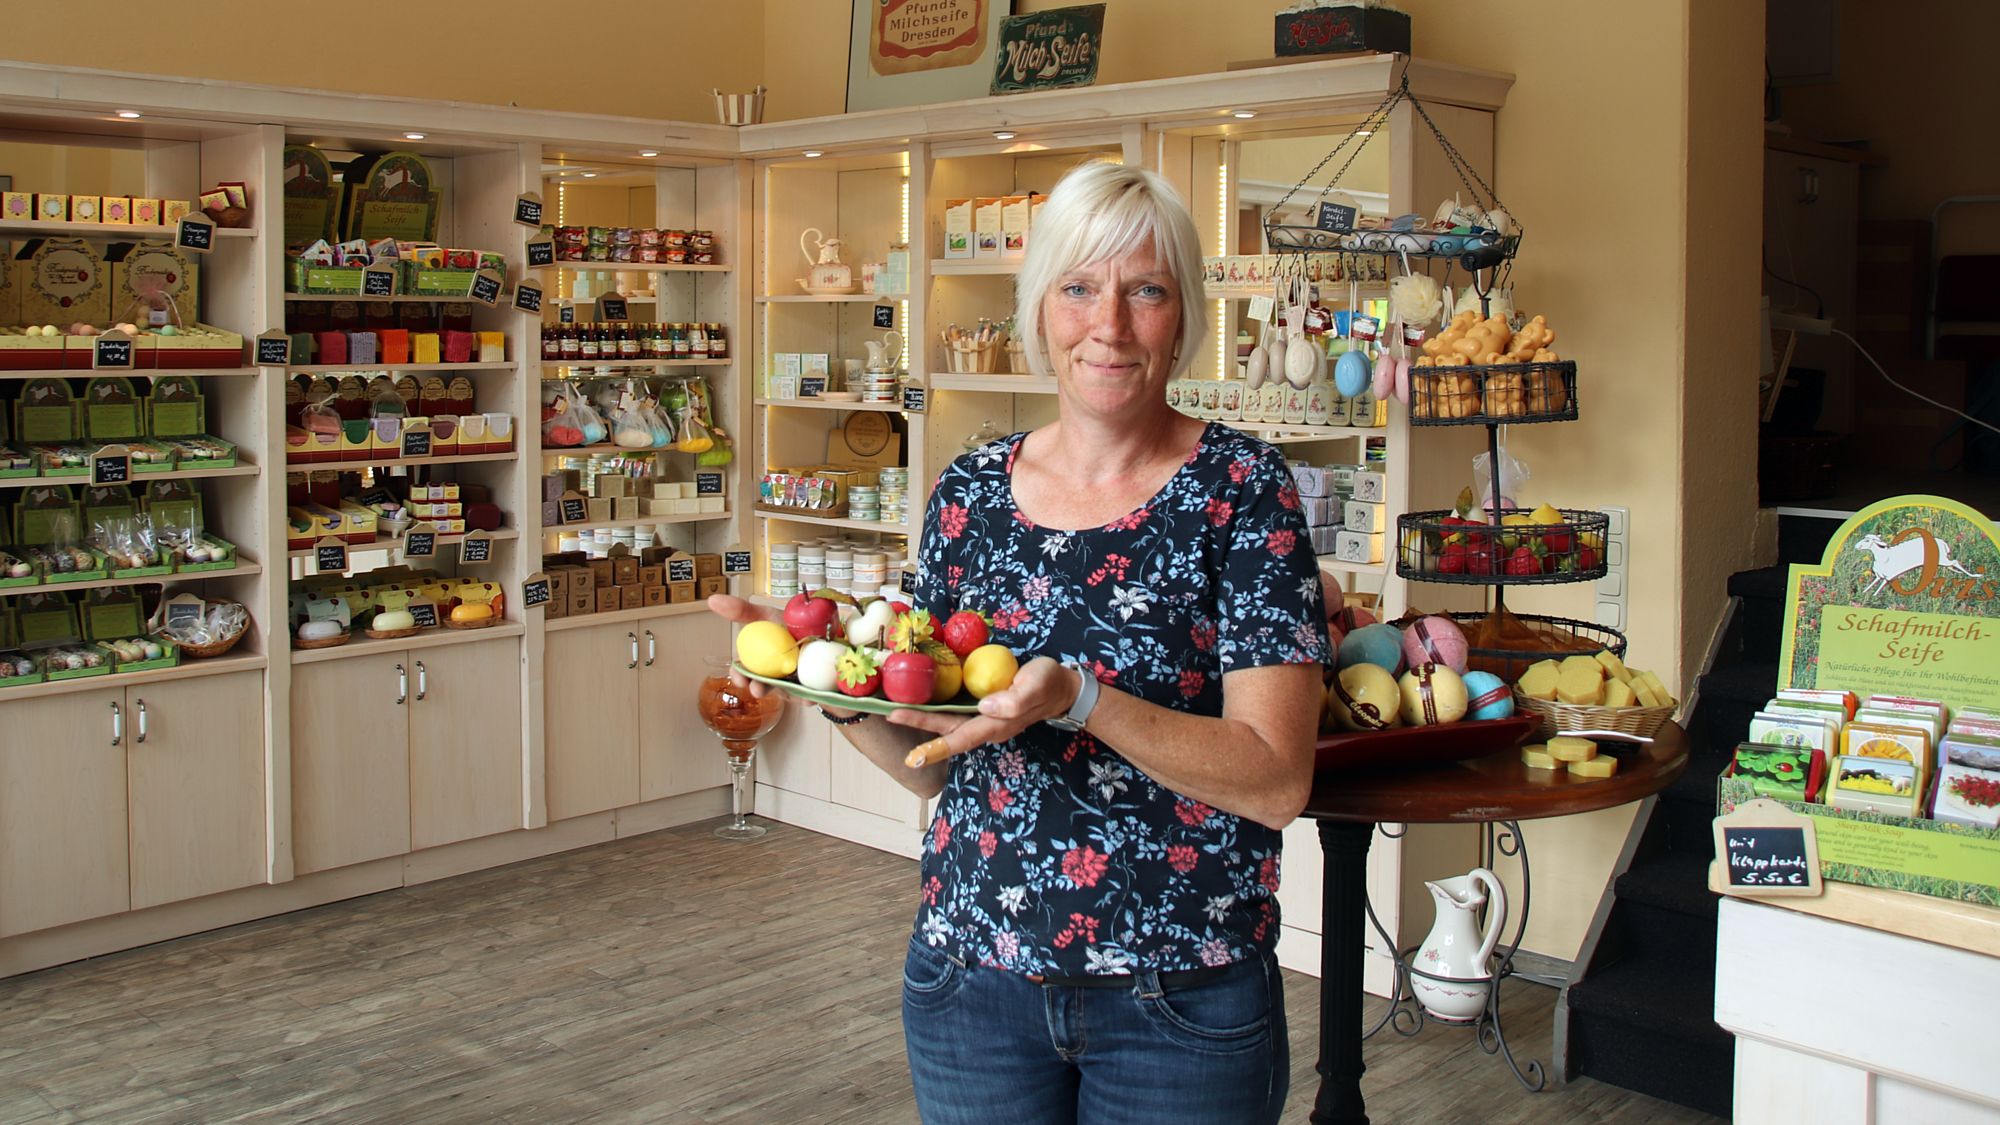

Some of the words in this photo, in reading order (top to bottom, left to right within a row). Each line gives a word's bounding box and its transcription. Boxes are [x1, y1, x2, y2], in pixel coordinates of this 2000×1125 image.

[906, 0, 957, 15] Pfunds
[890, 9, 968, 31] Milchseife
[901, 26, 955, 43] Dresden
[1837, 613, 1992, 641] Schafmilch-
[1878, 640, 1945, 667] Seife
[1824, 661, 1872, 673] Natürliche
[1873, 665, 1901, 678] Pflege
[1902, 669, 1918, 679] für
[1919, 670, 1934, 680] Ihr
[1788, 873, 1802, 884] €
